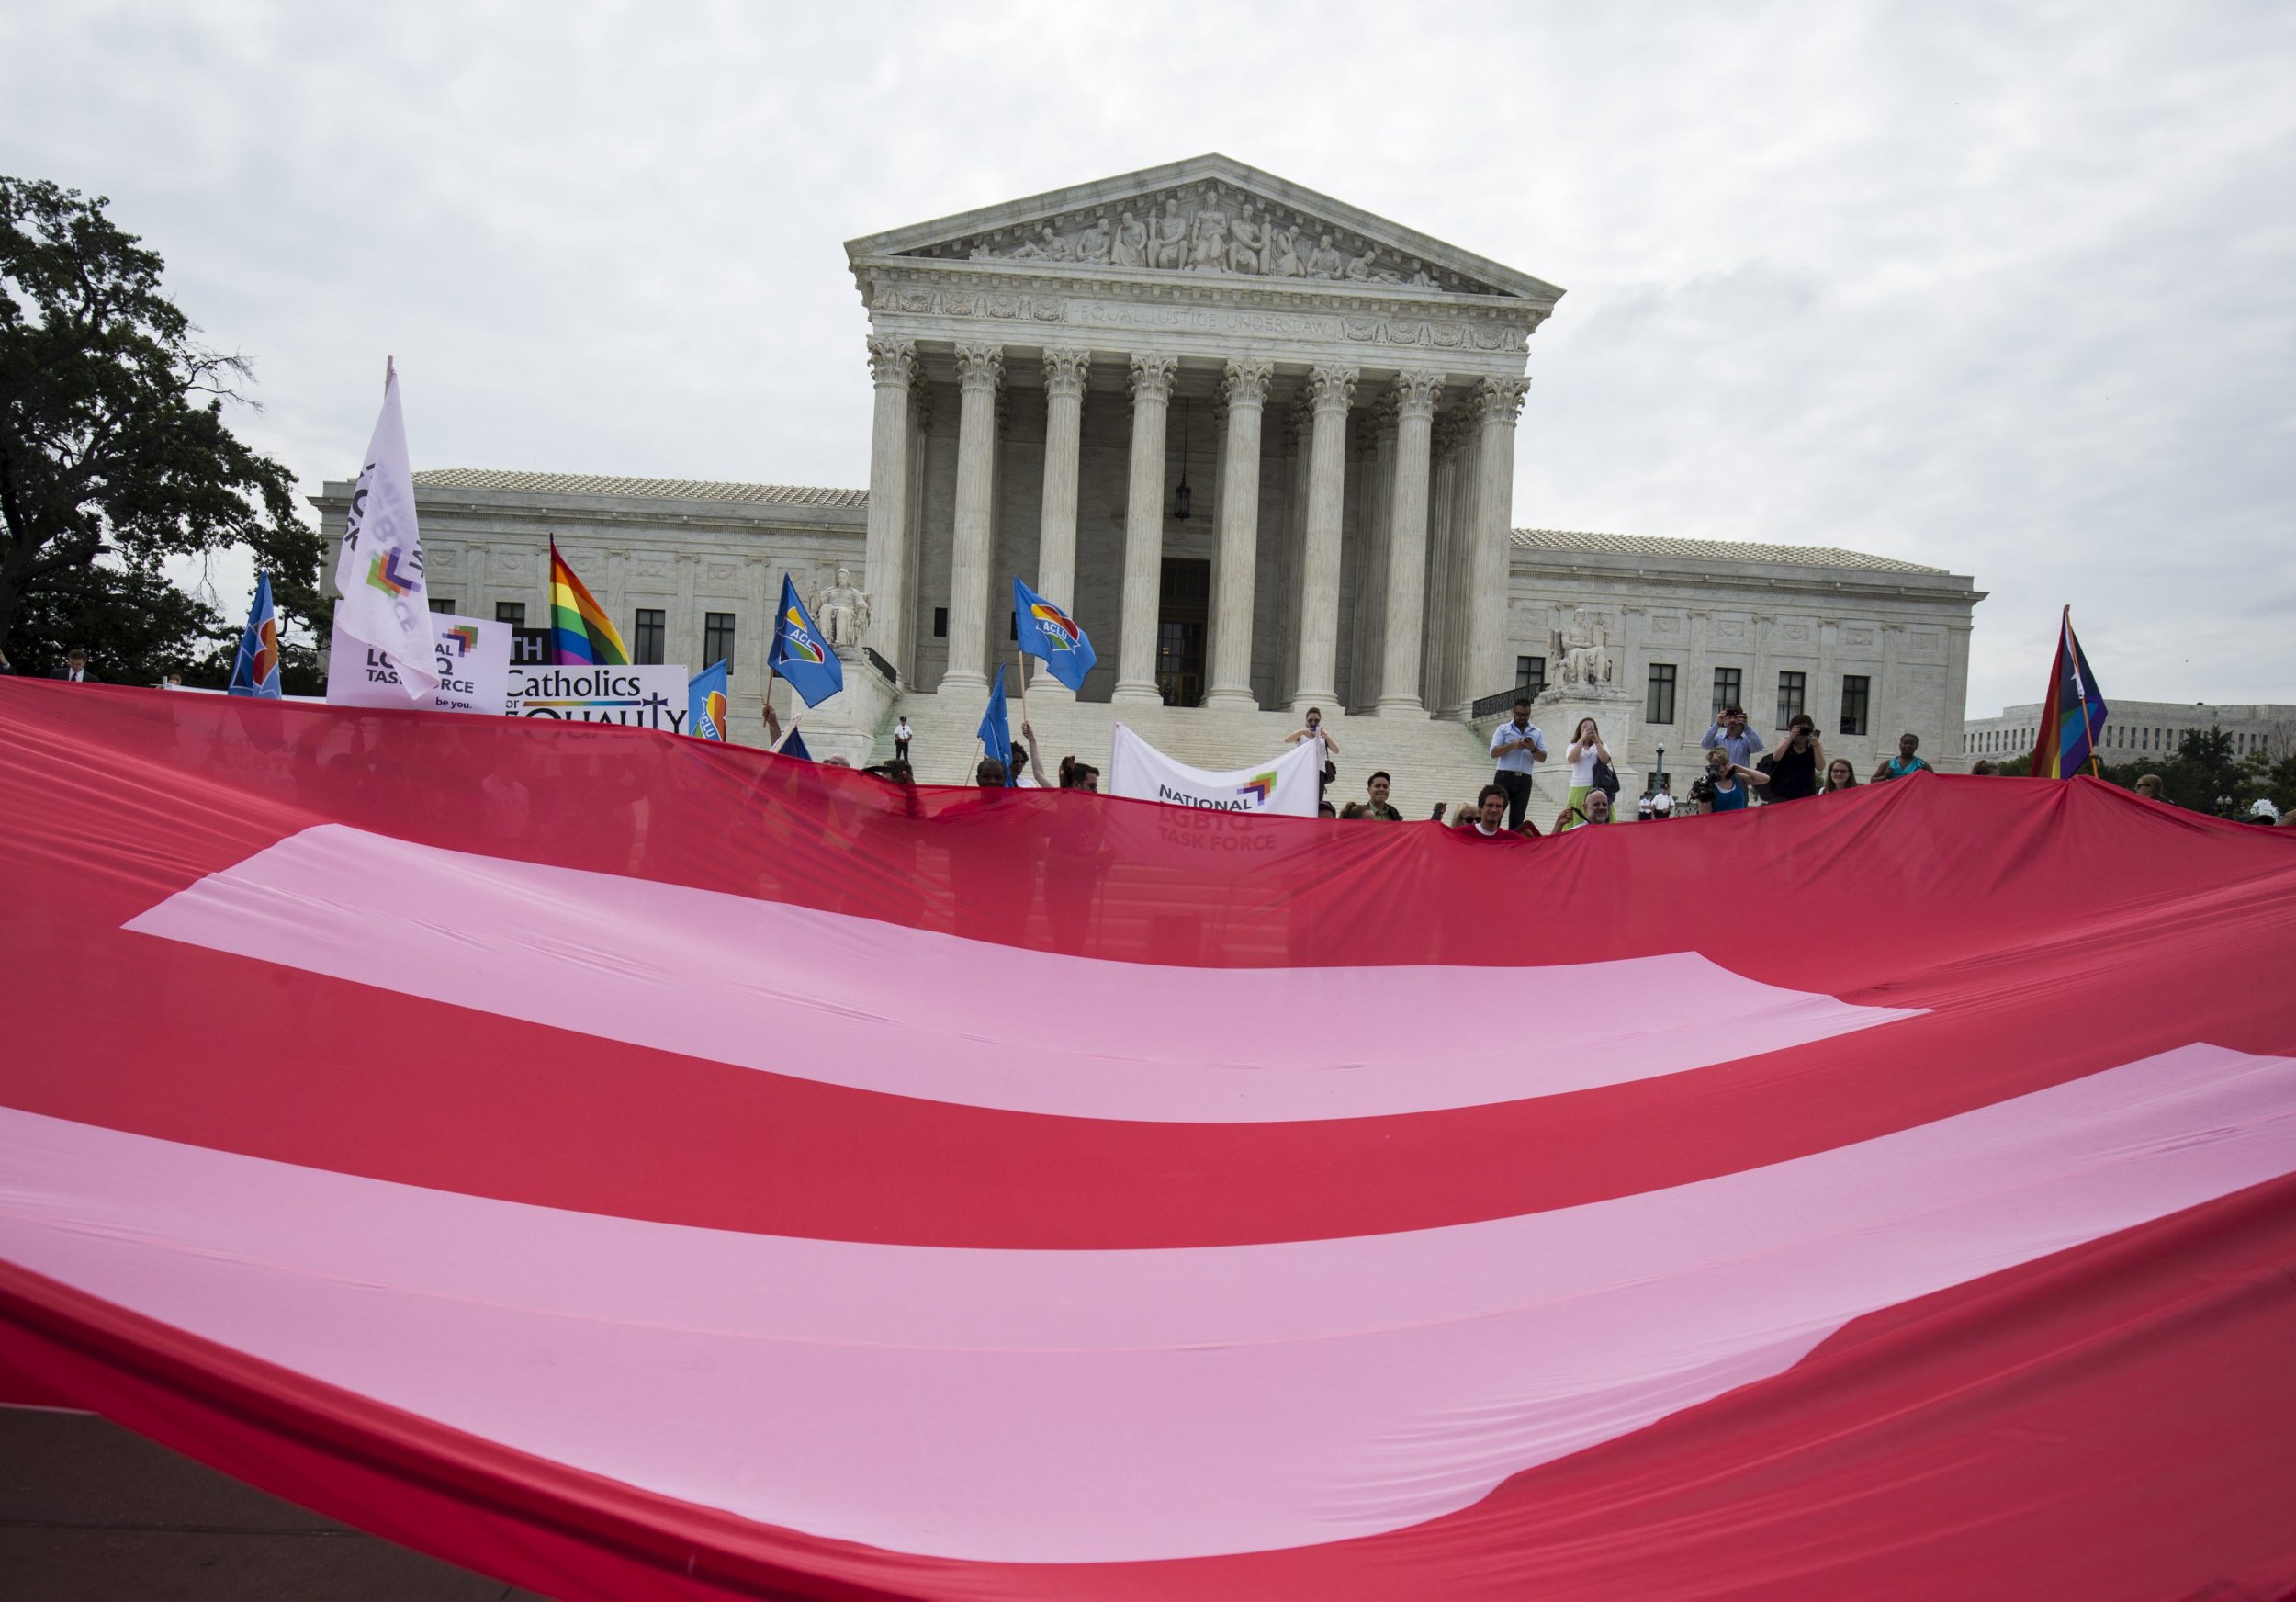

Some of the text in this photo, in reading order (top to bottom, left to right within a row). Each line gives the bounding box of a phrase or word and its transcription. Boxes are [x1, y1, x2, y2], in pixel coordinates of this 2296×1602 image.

[1081, 305, 1328, 334] EQUAL JUSTICE UNDER LAW
[790, 629, 816, 651] ACL
[1043, 621, 1067, 640] ACLU
[366, 669, 403, 685] TAS
[435, 697, 472, 710] be you.
[1159, 784, 1254, 811] NATIONAL
[1158, 826, 1277, 852] TASK FORCE
